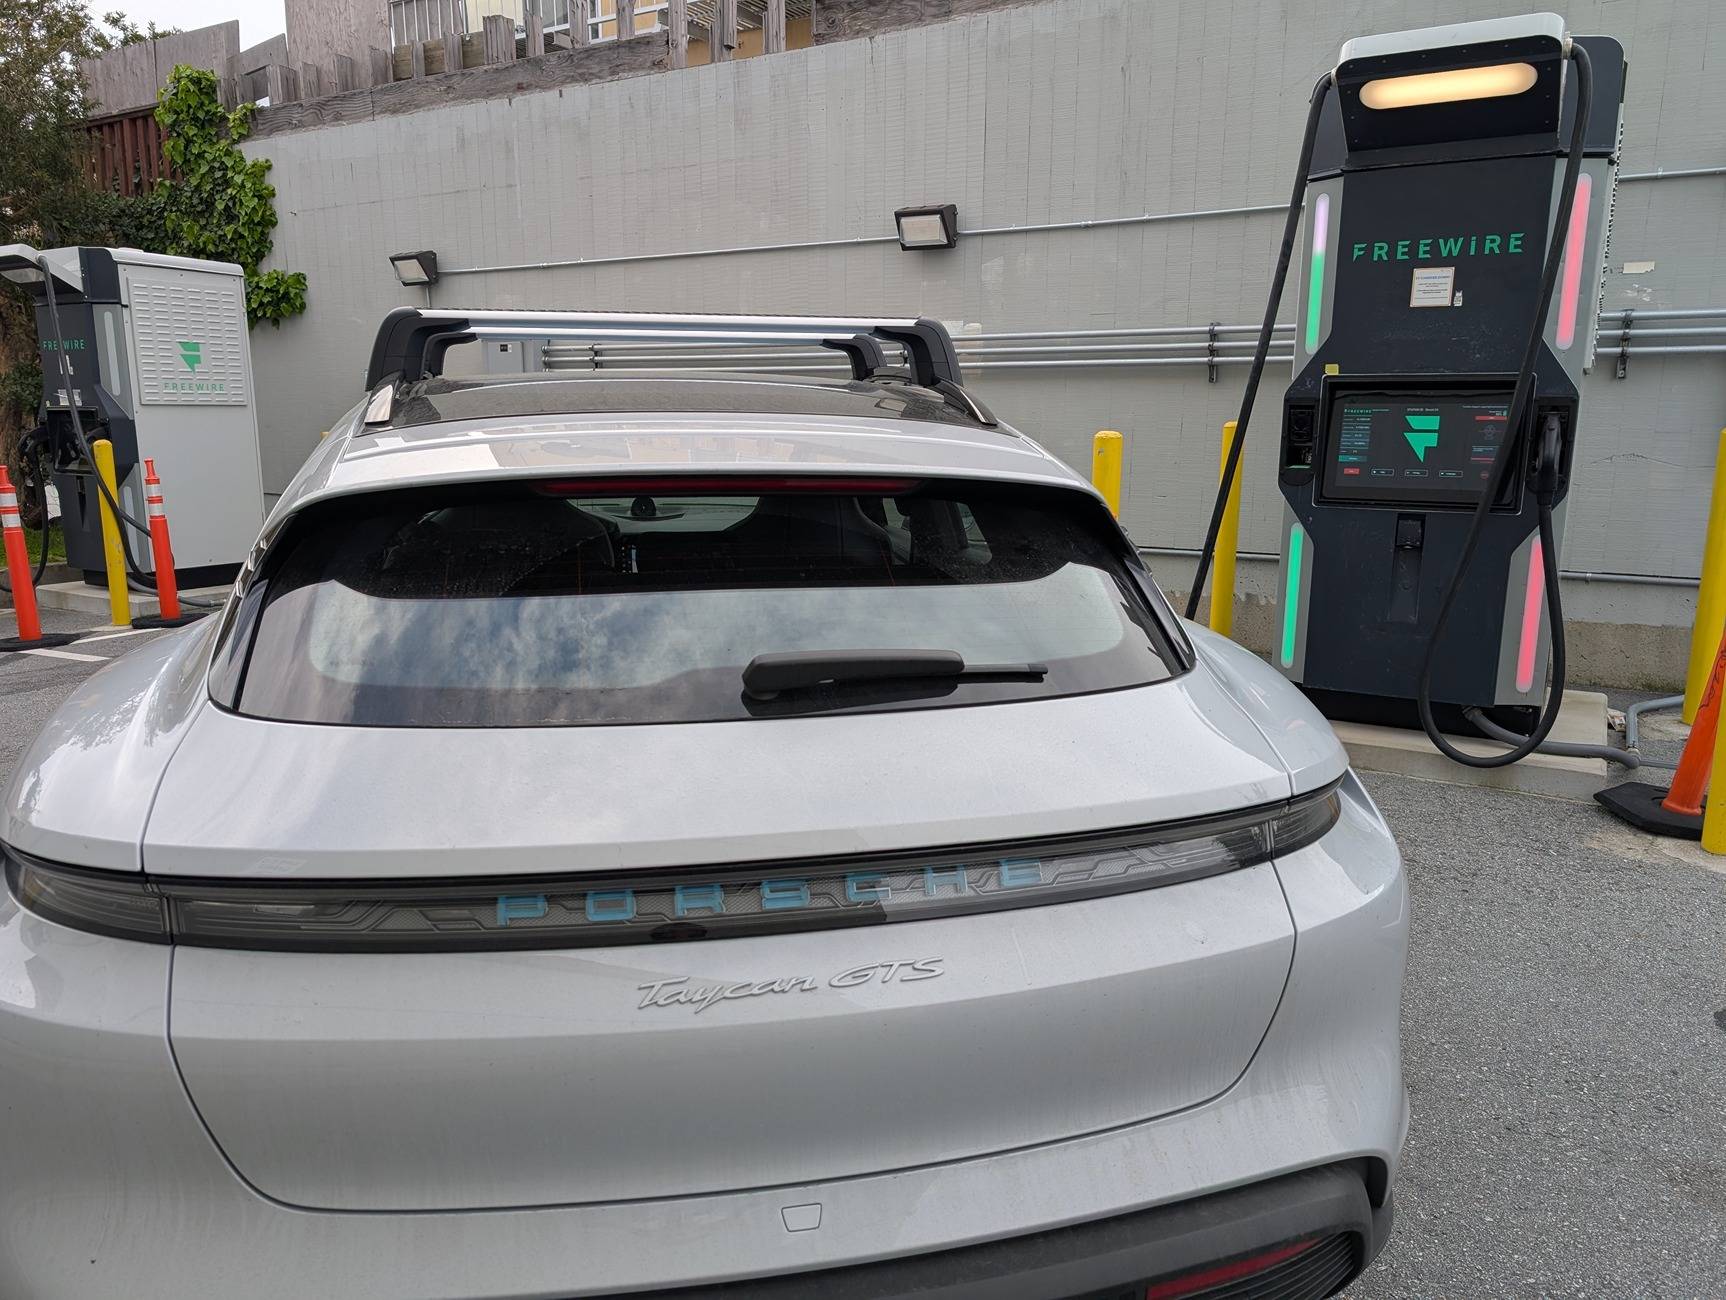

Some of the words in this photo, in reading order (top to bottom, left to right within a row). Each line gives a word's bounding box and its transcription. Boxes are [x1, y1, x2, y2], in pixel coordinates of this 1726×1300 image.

[42, 339, 85, 351] FREWIRE
[164, 382, 225, 392] FREEWIRE
[496, 857, 1043, 926] PORSCHE
[636, 975, 819, 1015] Taycan
[829, 955, 946, 989] GTS
